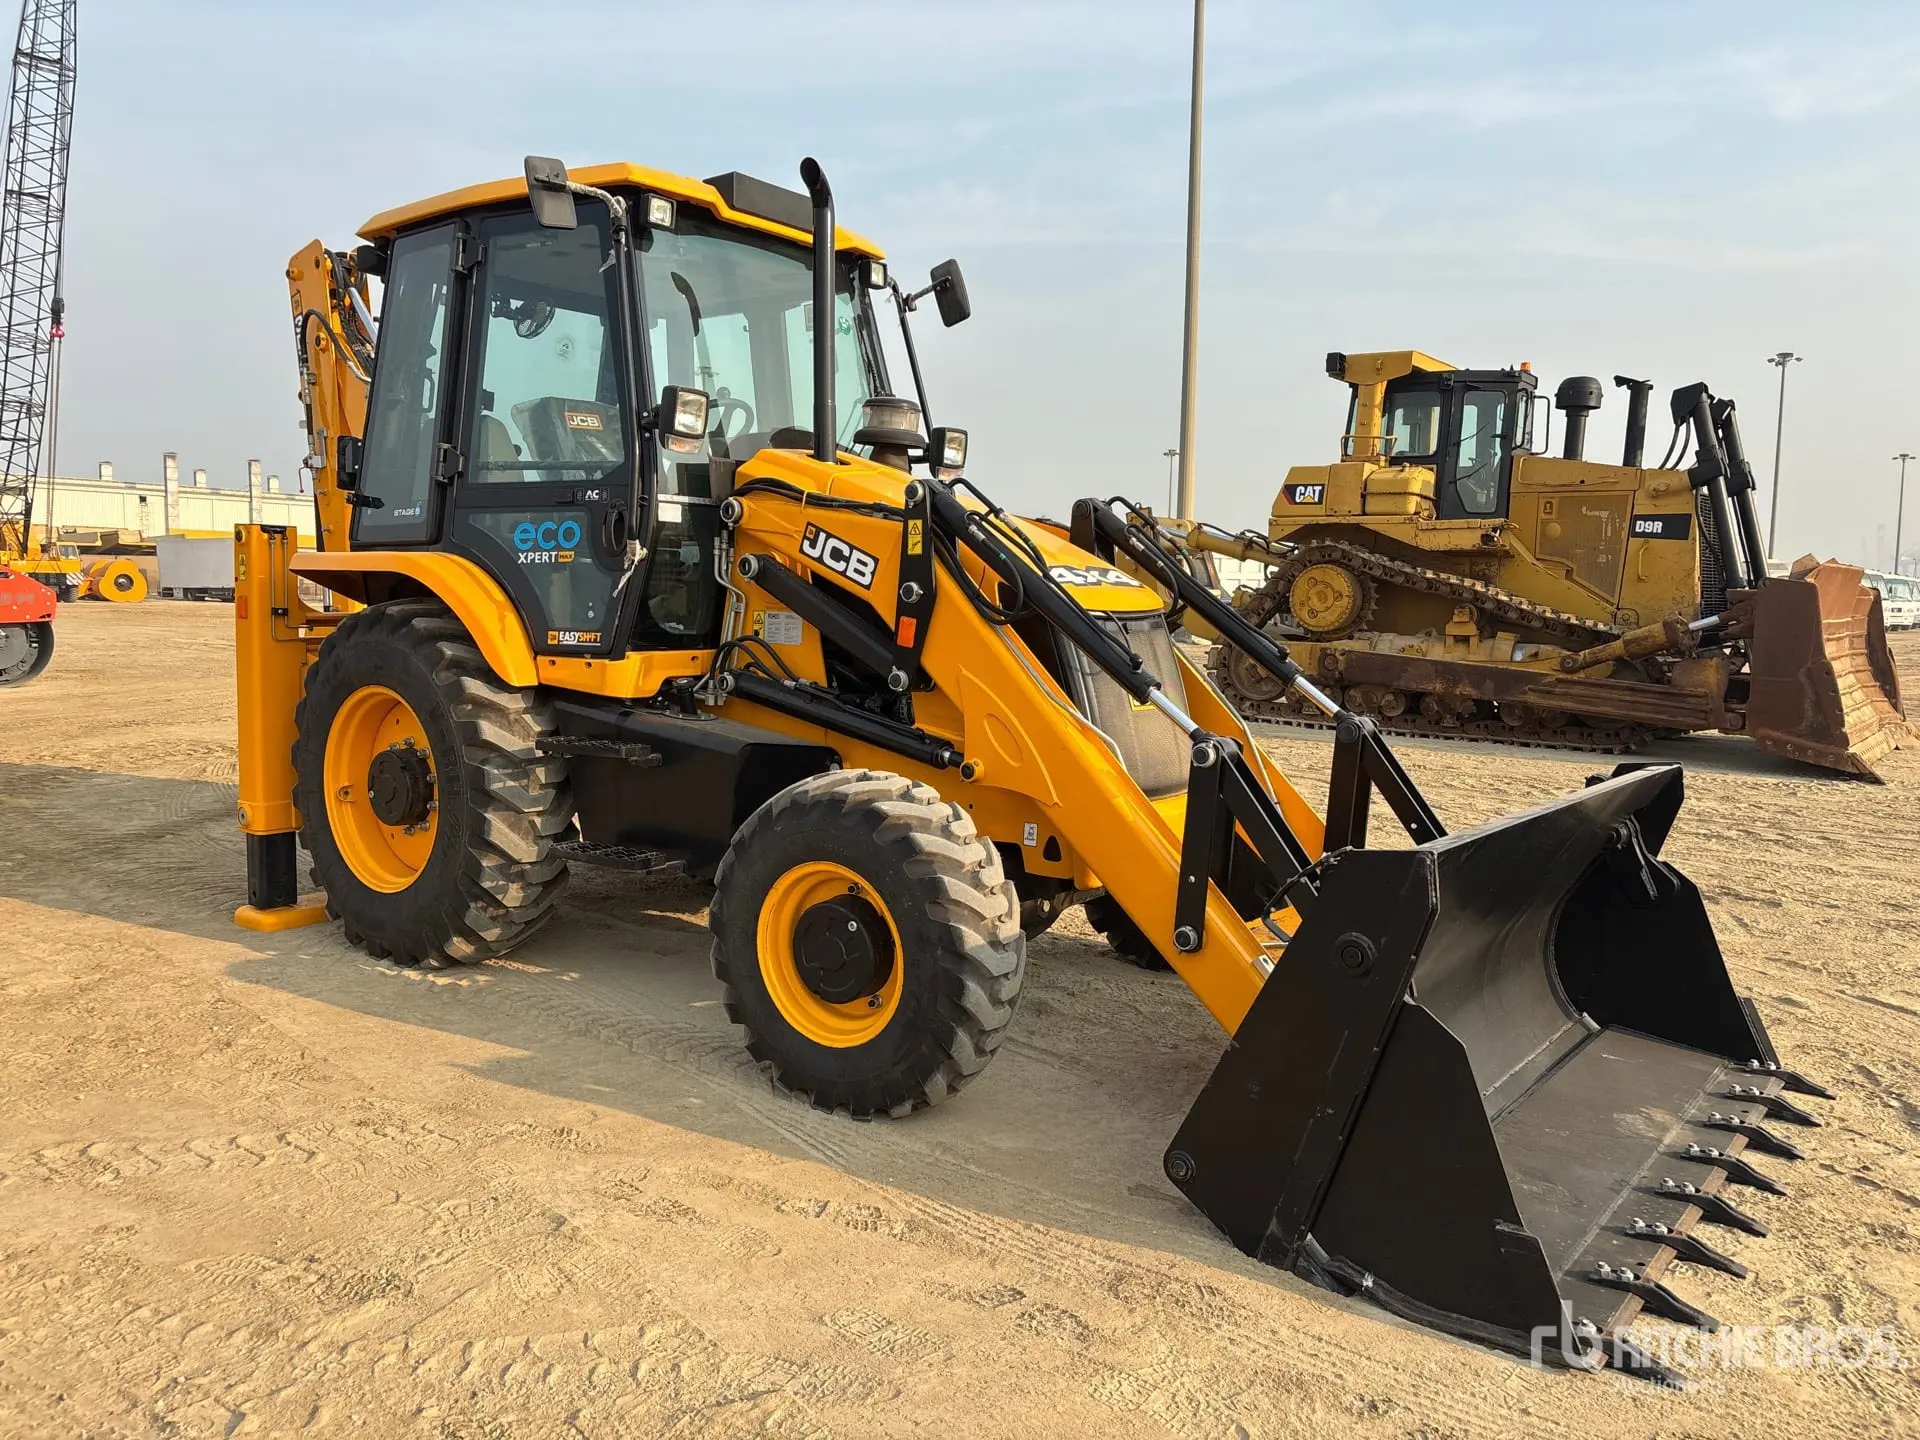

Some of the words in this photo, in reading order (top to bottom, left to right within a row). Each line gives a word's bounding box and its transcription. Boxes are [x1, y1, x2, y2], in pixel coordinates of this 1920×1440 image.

[570, 416, 599, 426] JCB
[585, 490, 599, 499] AC
[1295, 486, 1322, 502] CAT
[394, 508, 414, 517] STAGE
[1635, 520, 1663, 533] D9R
[514, 520, 581, 550] eco
[518, 552, 557, 564] XPERT
[802, 532, 875, 586] JCB
